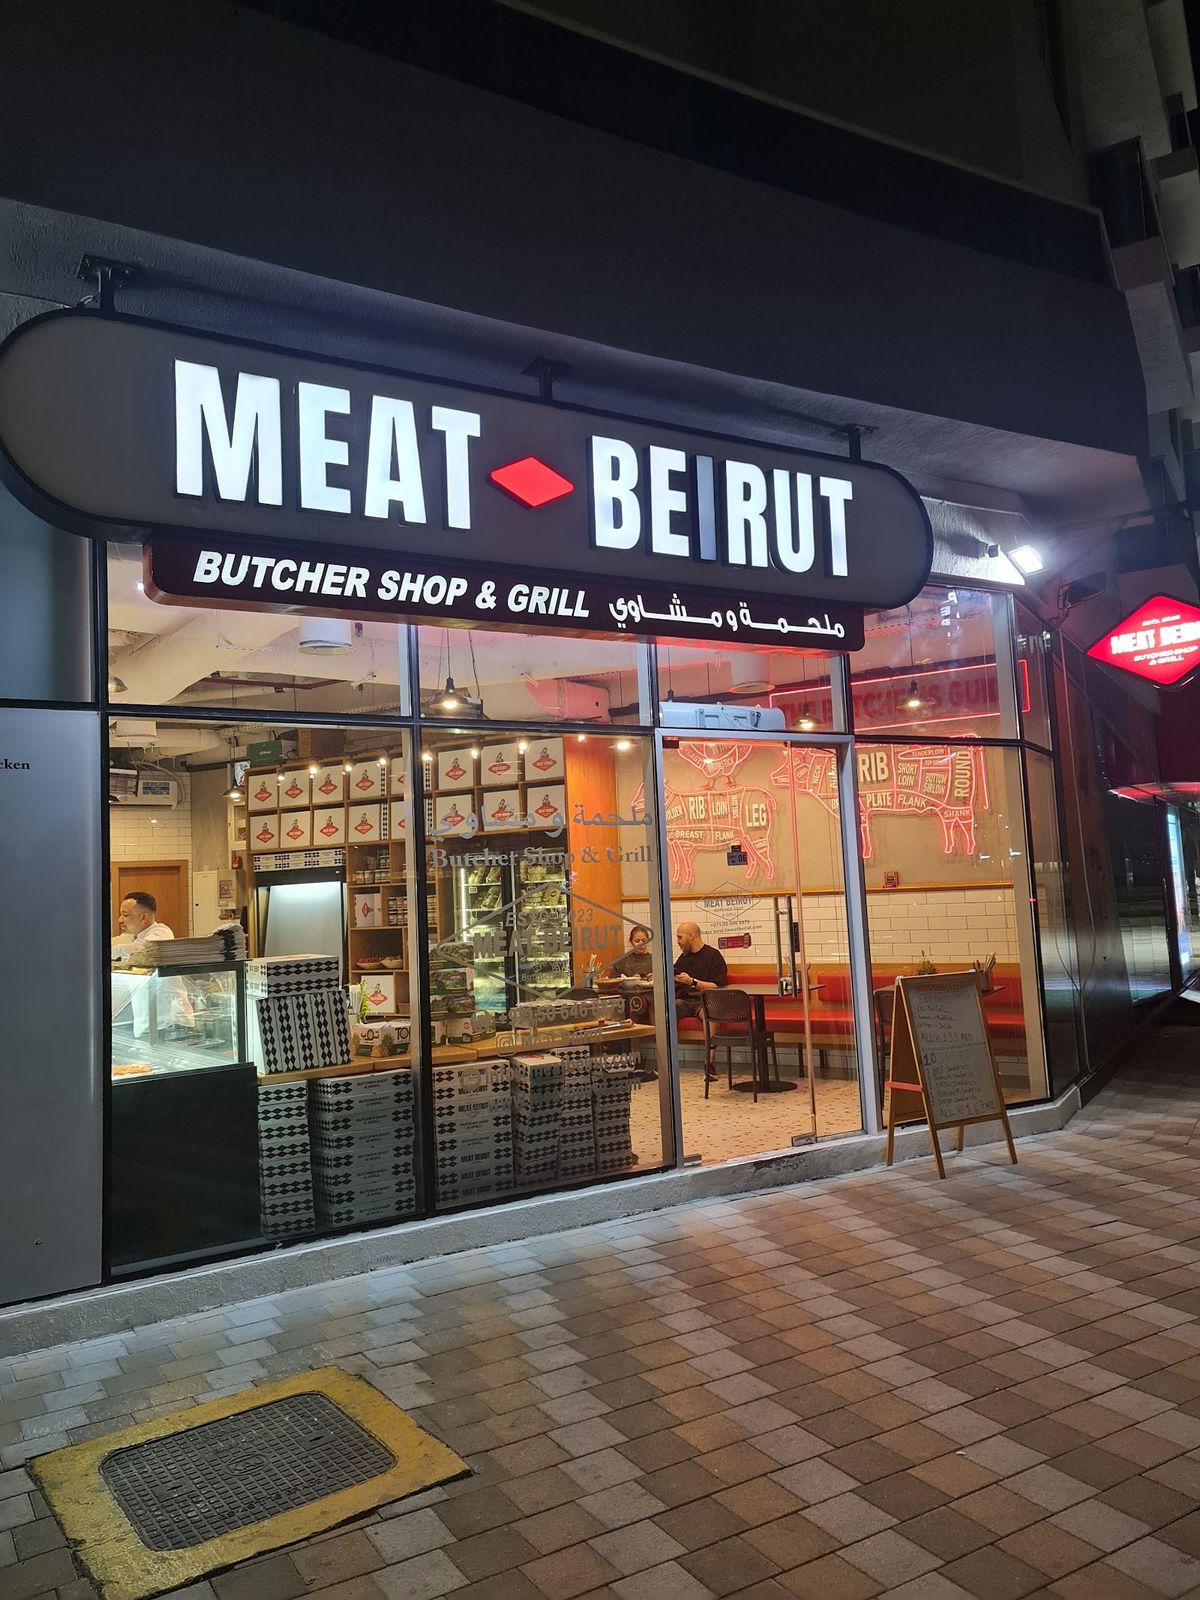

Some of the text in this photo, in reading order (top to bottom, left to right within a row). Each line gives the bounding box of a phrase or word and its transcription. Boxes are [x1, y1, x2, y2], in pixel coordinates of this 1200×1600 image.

[174, 358, 853, 577] MEAT BEIRUT
[193, 550, 590, 618] BUTCHER SHOP & GRILL
[739, 601, 845, 638] ملحمة
[1110, 628, 1156, 655] MEAT
[858, 751, 889, 783] RIB
[898, 763, 918, 775] SHORT
[954, 750, 971, 798] ROUND
[898, 775, 914, 786] LOIN
[925, 772, 947, 784] BOTTOM
[923, 783, 945, 795] SIRLOIN
[866, 792, 892, 808] PLATE
[898, 794, 927, 808] FLANK
[688, 796, 706, 820] RIB
[711, 801, 728, 816] LOIN
[944, 808, 971, 818] SHANK
[745, 804, 767, 828] LEG
[675, 830, 704, 839] BREAST
[715, 832, 735, 840] FLANK
[432, 844, 653, 874] Butcher Shop & Grill
[704, 895, 752, 908] MEAT BEIRUT
[473, 924, 623, 958] MEAT BEIRUT
[923, 1052, 937, 1066] 10
